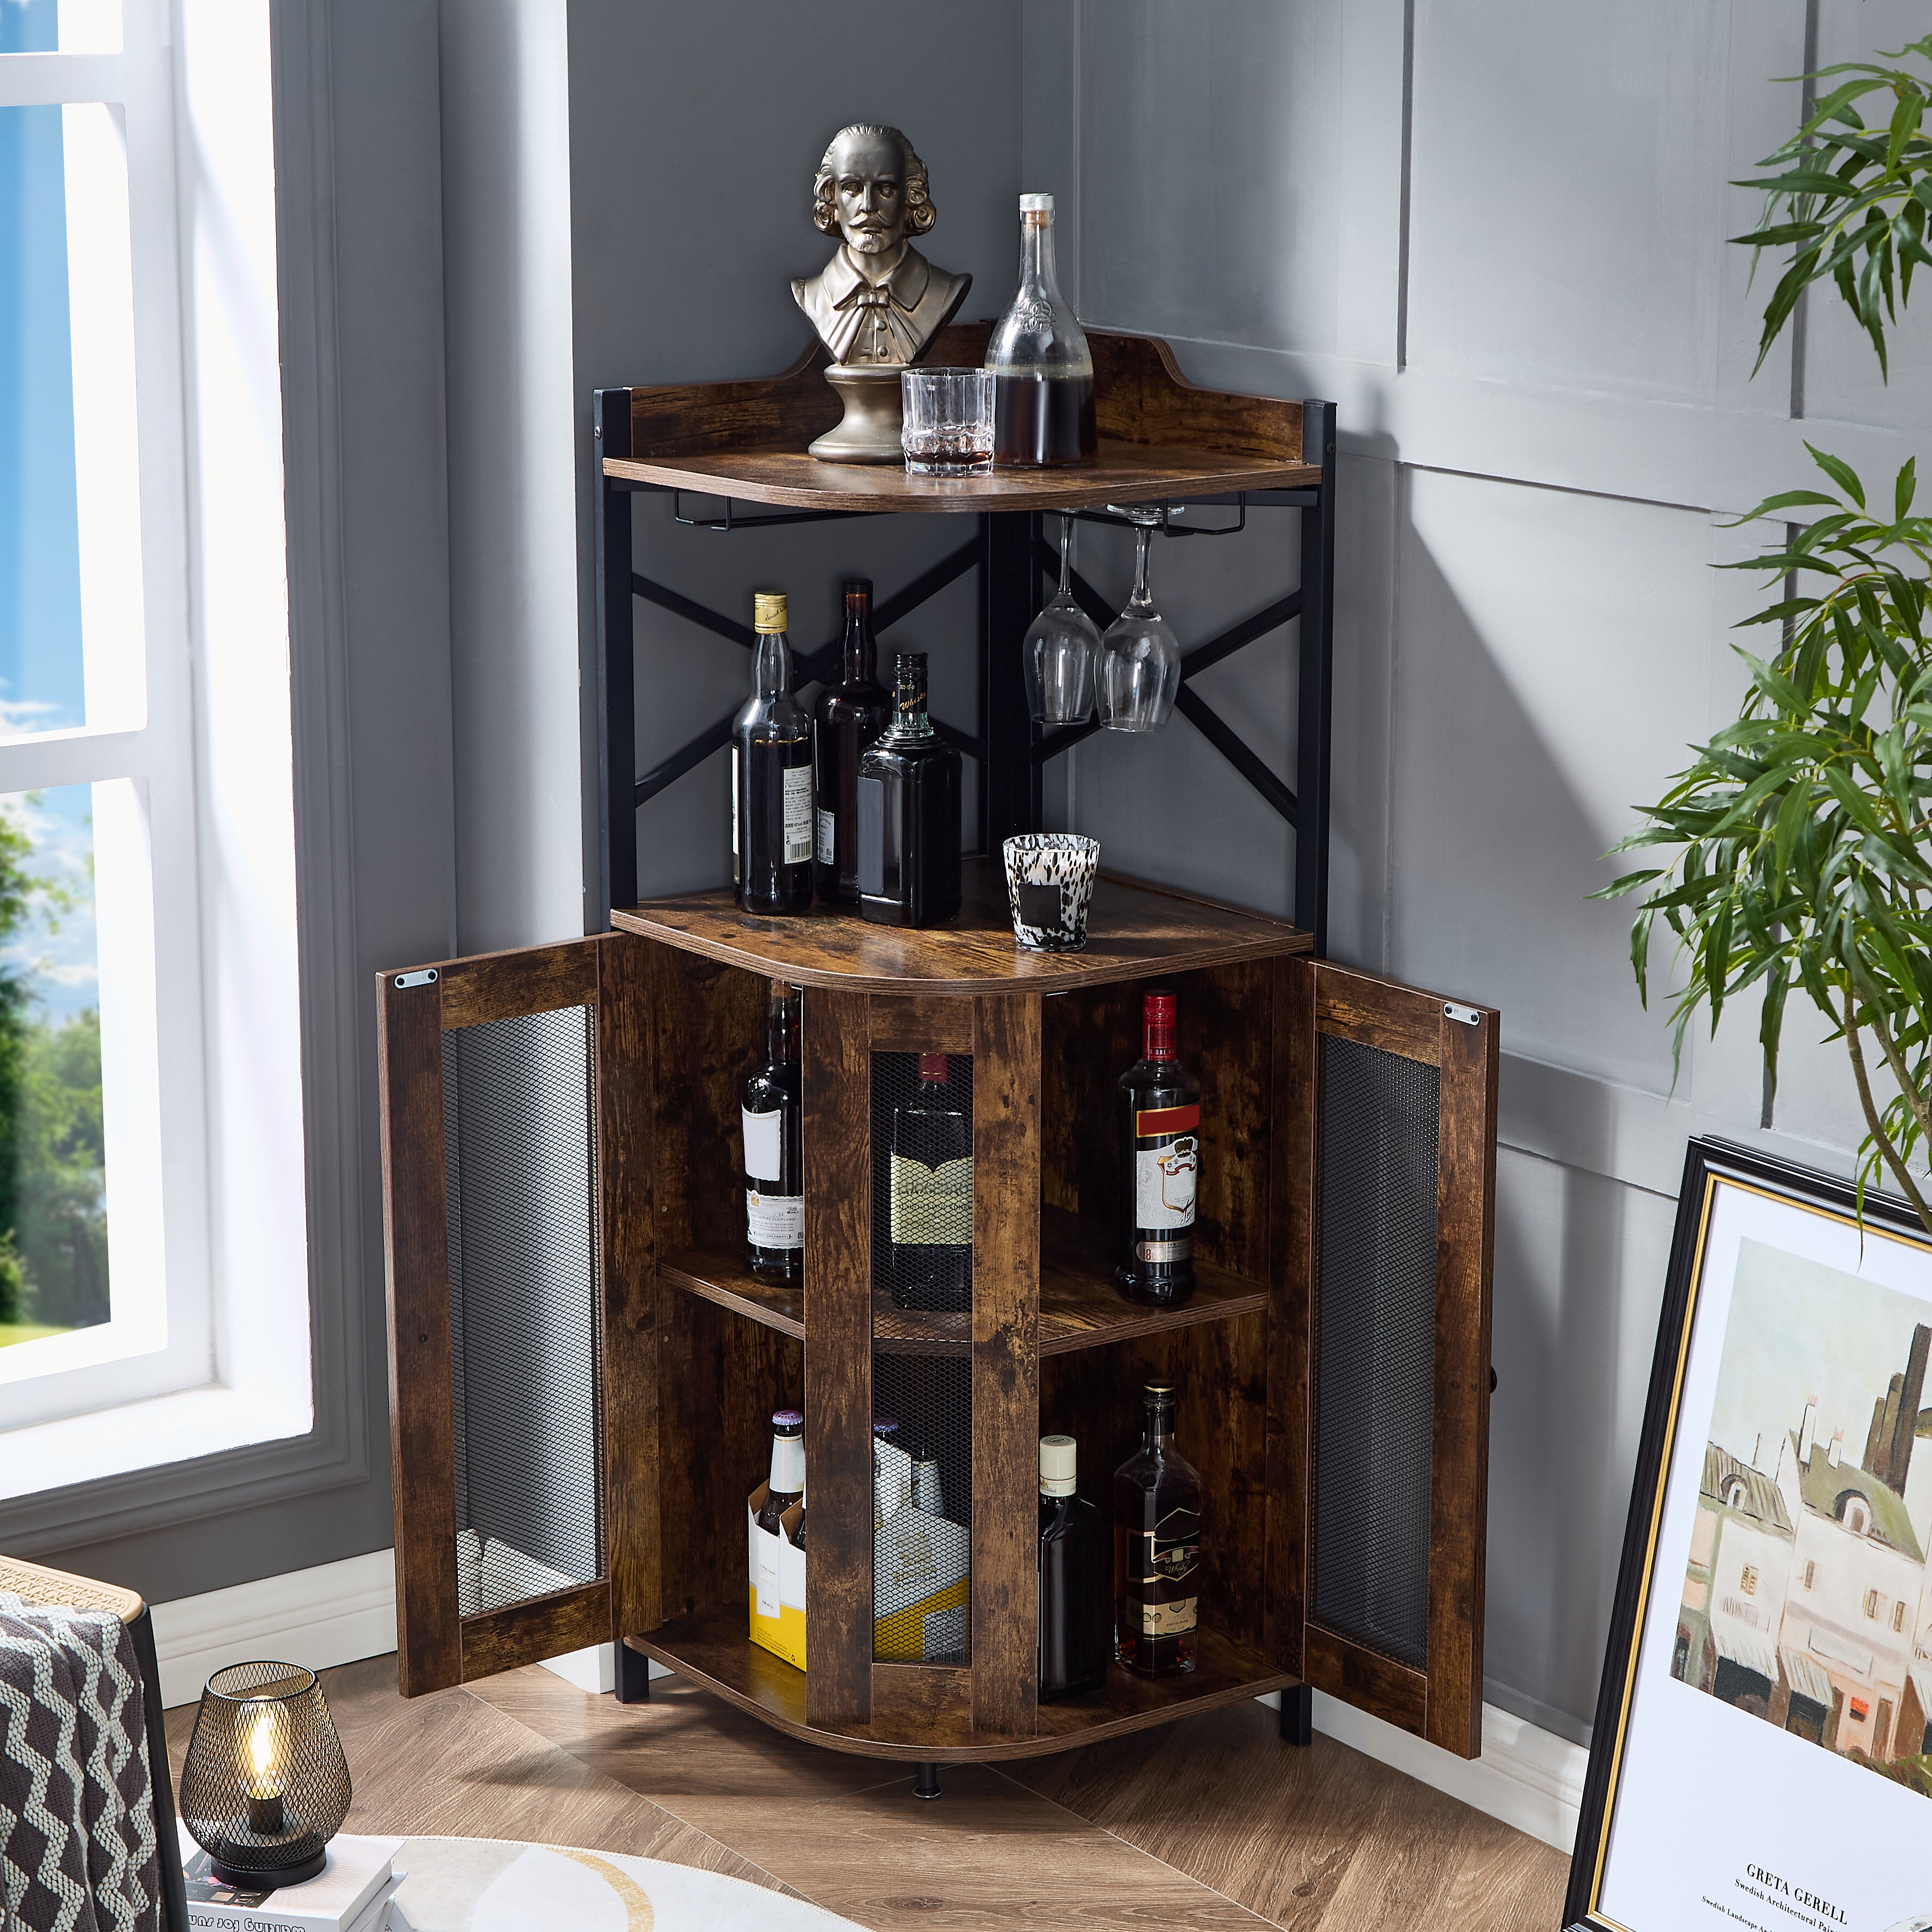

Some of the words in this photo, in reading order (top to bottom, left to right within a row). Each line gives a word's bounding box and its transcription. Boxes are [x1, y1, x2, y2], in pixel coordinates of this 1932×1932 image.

[1165, 1560, 1190, 1576] Whisky
[1734, 1879, 1764, 1900] Swedish
[1766, 1895, 1816, 1927] Architectural
[1747, 1864, 1790, 1896] GRETA
[1794, 1888, 1847, 1925] GERELL
[217, 1918, 240, 1932] for
[1702, 1895, 1726, 1913] Swedish
[1727, 1909, 1758, 1930] Landscape
